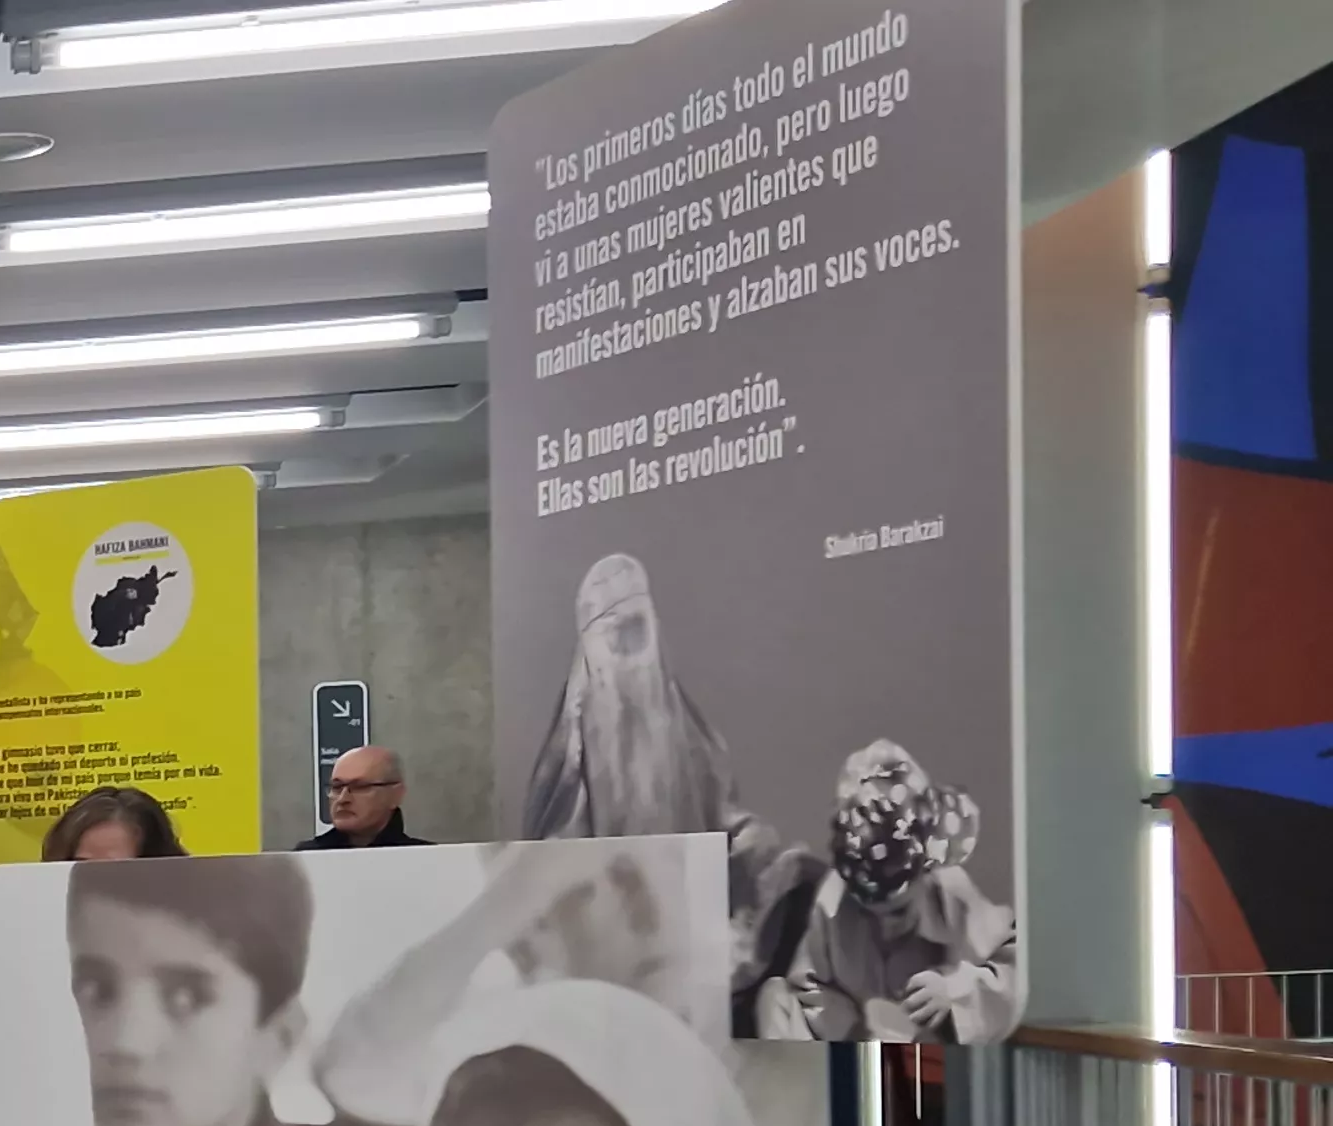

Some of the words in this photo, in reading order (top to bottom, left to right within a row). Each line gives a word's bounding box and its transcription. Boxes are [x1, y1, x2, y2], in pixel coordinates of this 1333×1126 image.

[535, 189, 599, 241] estaba
[605, 122, 769, 214] conmocionado,
[777, 100, 831, 157] pero
[840, 68, 909, 123] luego
[584, 111, 676, 183] primeros
[683, 88, 727, 134] días
[733, 61, 784, 112] todo
[793, 43, 814, 88] el
[822, 9, 908, 77] mundo
[535, 248, 551, 287] vi
[556, 250, 568, 280] a
[575, 230, 621, 273] unas
[627, 197, 713, 254] mujeres
[719, 155, 824, 220] valientes
[833, 136, 877, 186] que
[536, 277, 626, 334] resistían,
[632, 226, 770, 308] participaban
[778, 214, 805, 251] en
[536, 300, 702, 379] manifestaciones
[708, 294, 721, 333] y
[727, 262, 817, 319] alzaban
[825, 246, 868, 288] sus
[874, 219, 960, 271] voces.
[537, 433, 559, 471] Es
[564, 428, 583, 464] la
[588, 414, 648, 457] nueva
[653, 372, 786, 447] generación.
[537, 477, 583, 517] Ellas
[588, 468, 623, 504] son
[629, 458, 660, 494] las
[880, 514, 944, 548] Barakzai
